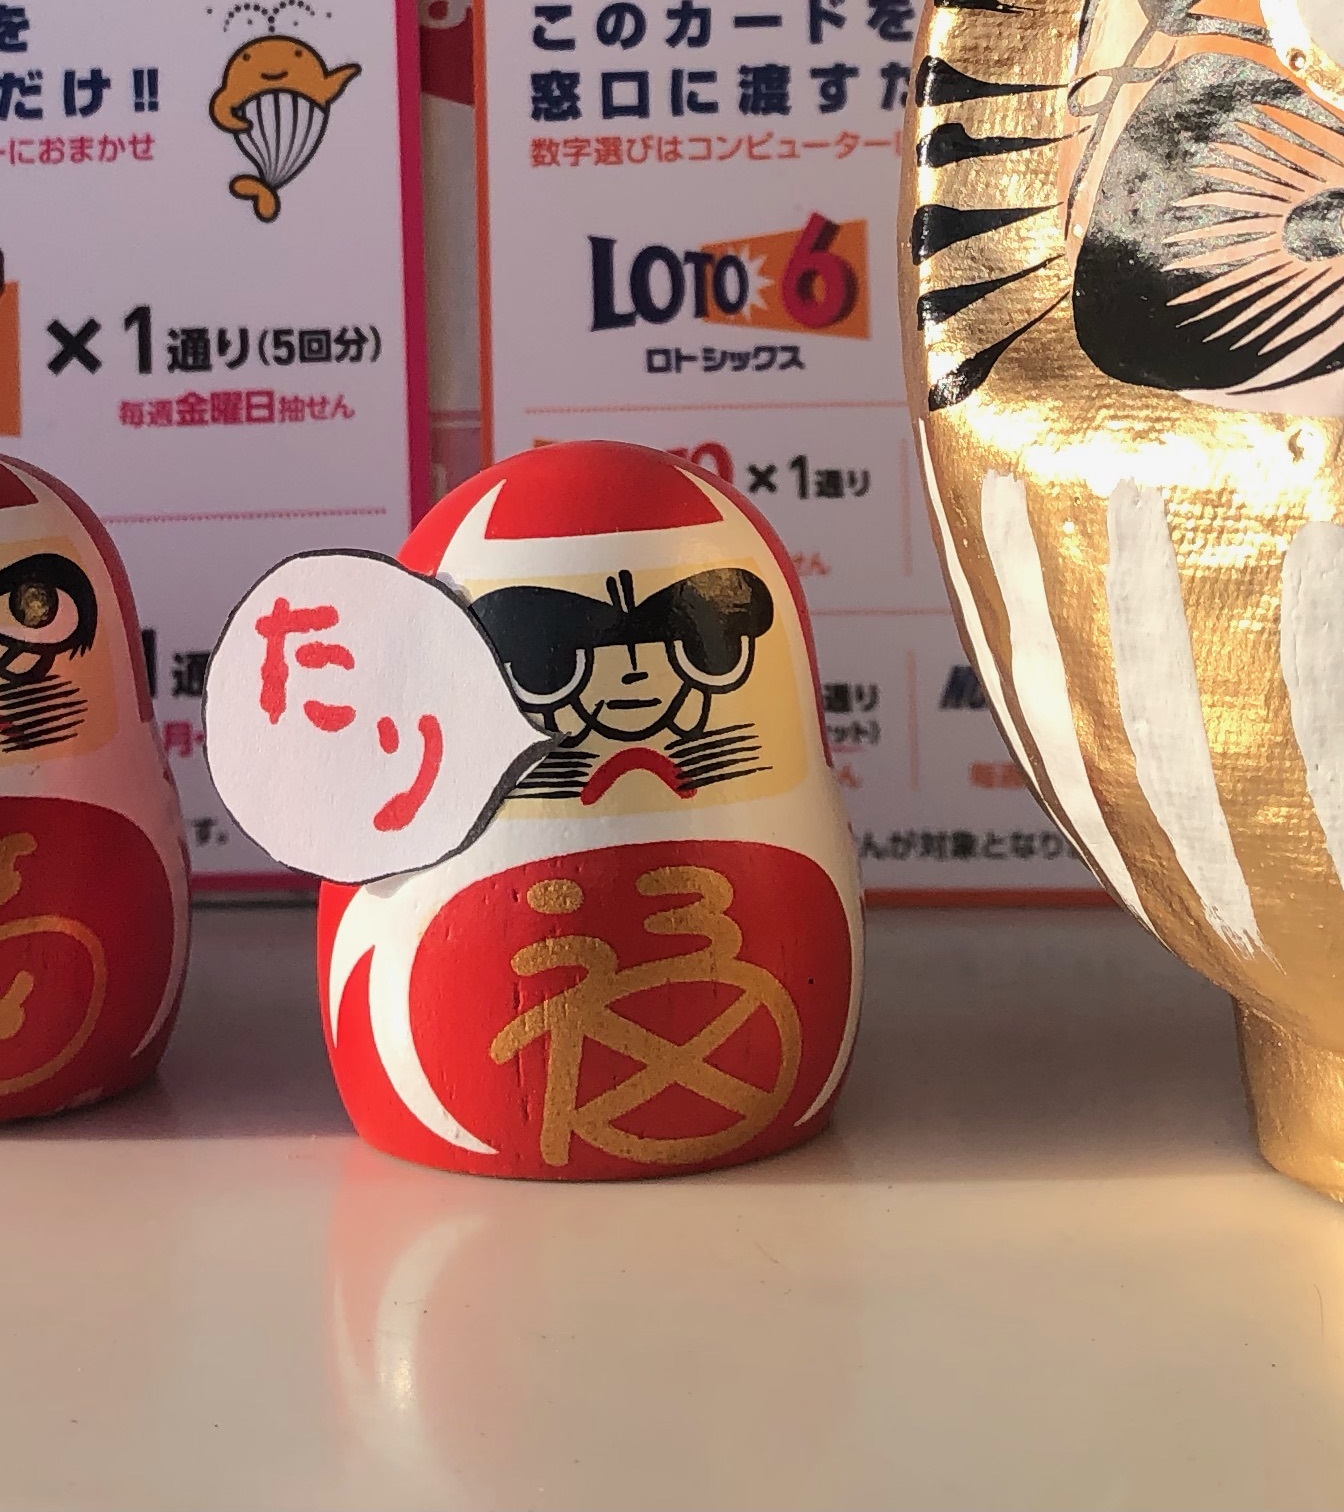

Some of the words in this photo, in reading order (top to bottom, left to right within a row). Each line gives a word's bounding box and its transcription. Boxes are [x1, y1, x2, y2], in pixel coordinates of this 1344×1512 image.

[530, 129, 902, 169] 数字選びはコンピューター
[588, 235, 749, 332] LOTO
[782, 211, 856, 329] 6
[647, 345, 805, 373] ロトシックス
[118, 389, 355, 428] 毎週金曜日抽せん
[256, 597, 443, 831] たり
